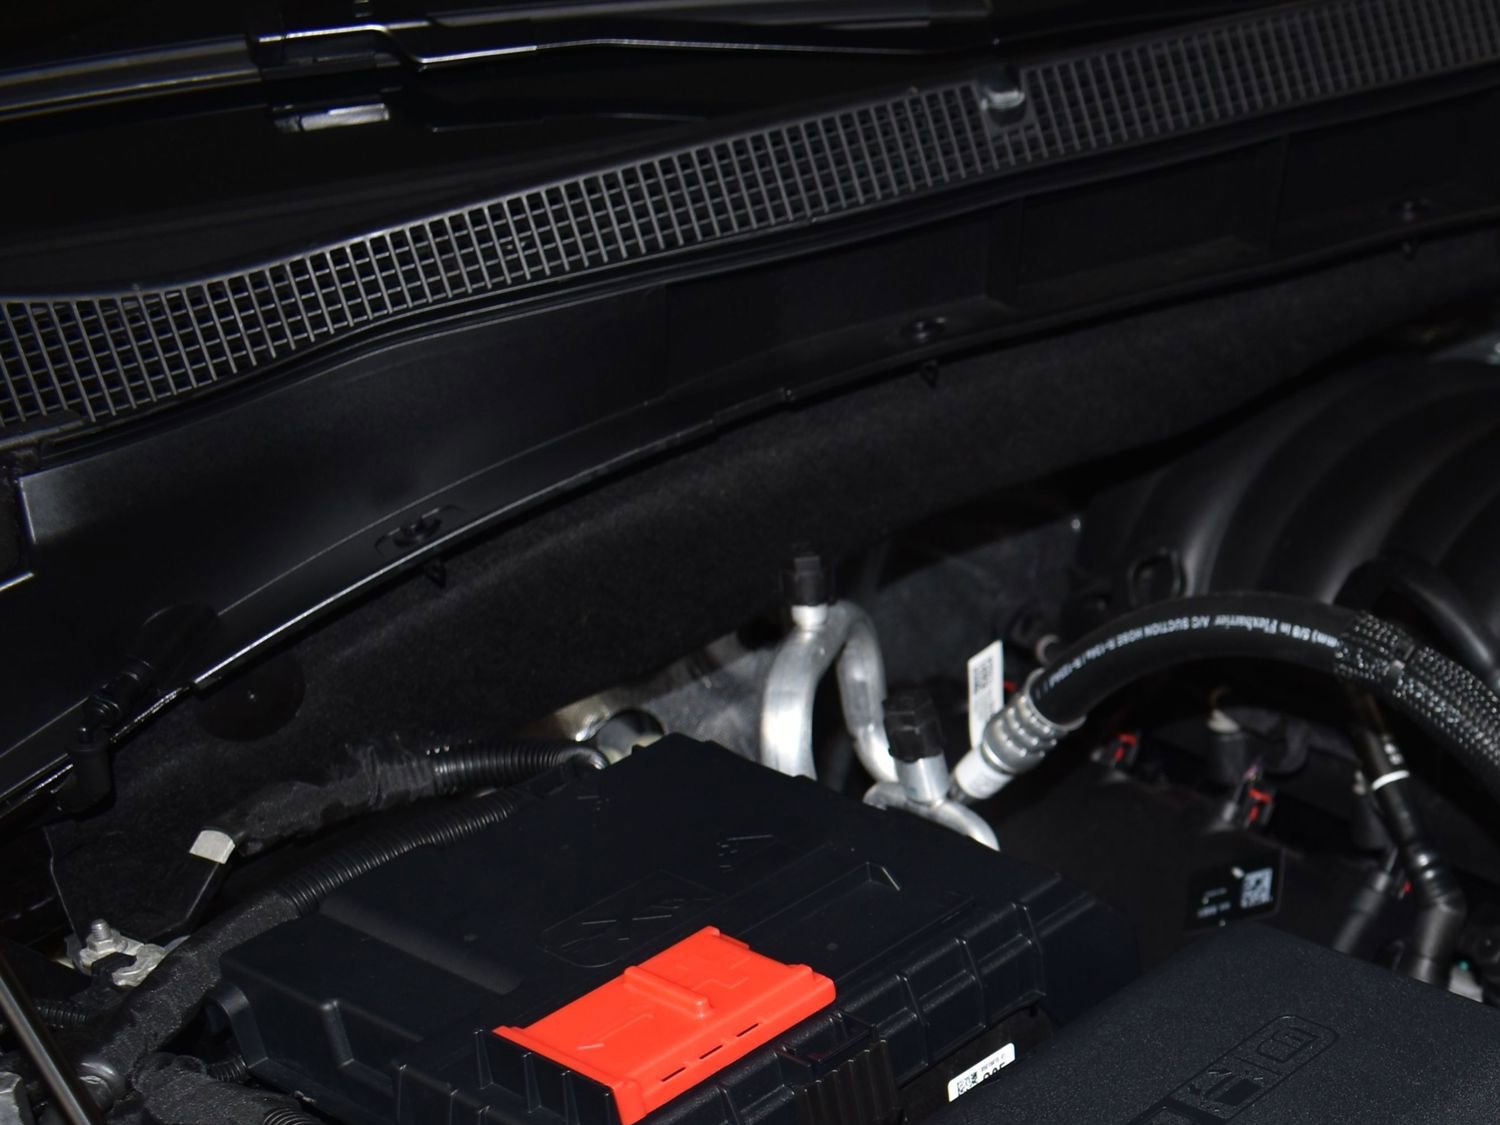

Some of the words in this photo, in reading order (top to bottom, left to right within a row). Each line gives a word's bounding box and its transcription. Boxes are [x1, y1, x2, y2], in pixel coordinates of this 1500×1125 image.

[1143, 616, 1191, 638] SUCTION
[1190, 615, 1211, 630] A/C
[1115, 627, 1145, 647] HOSE
